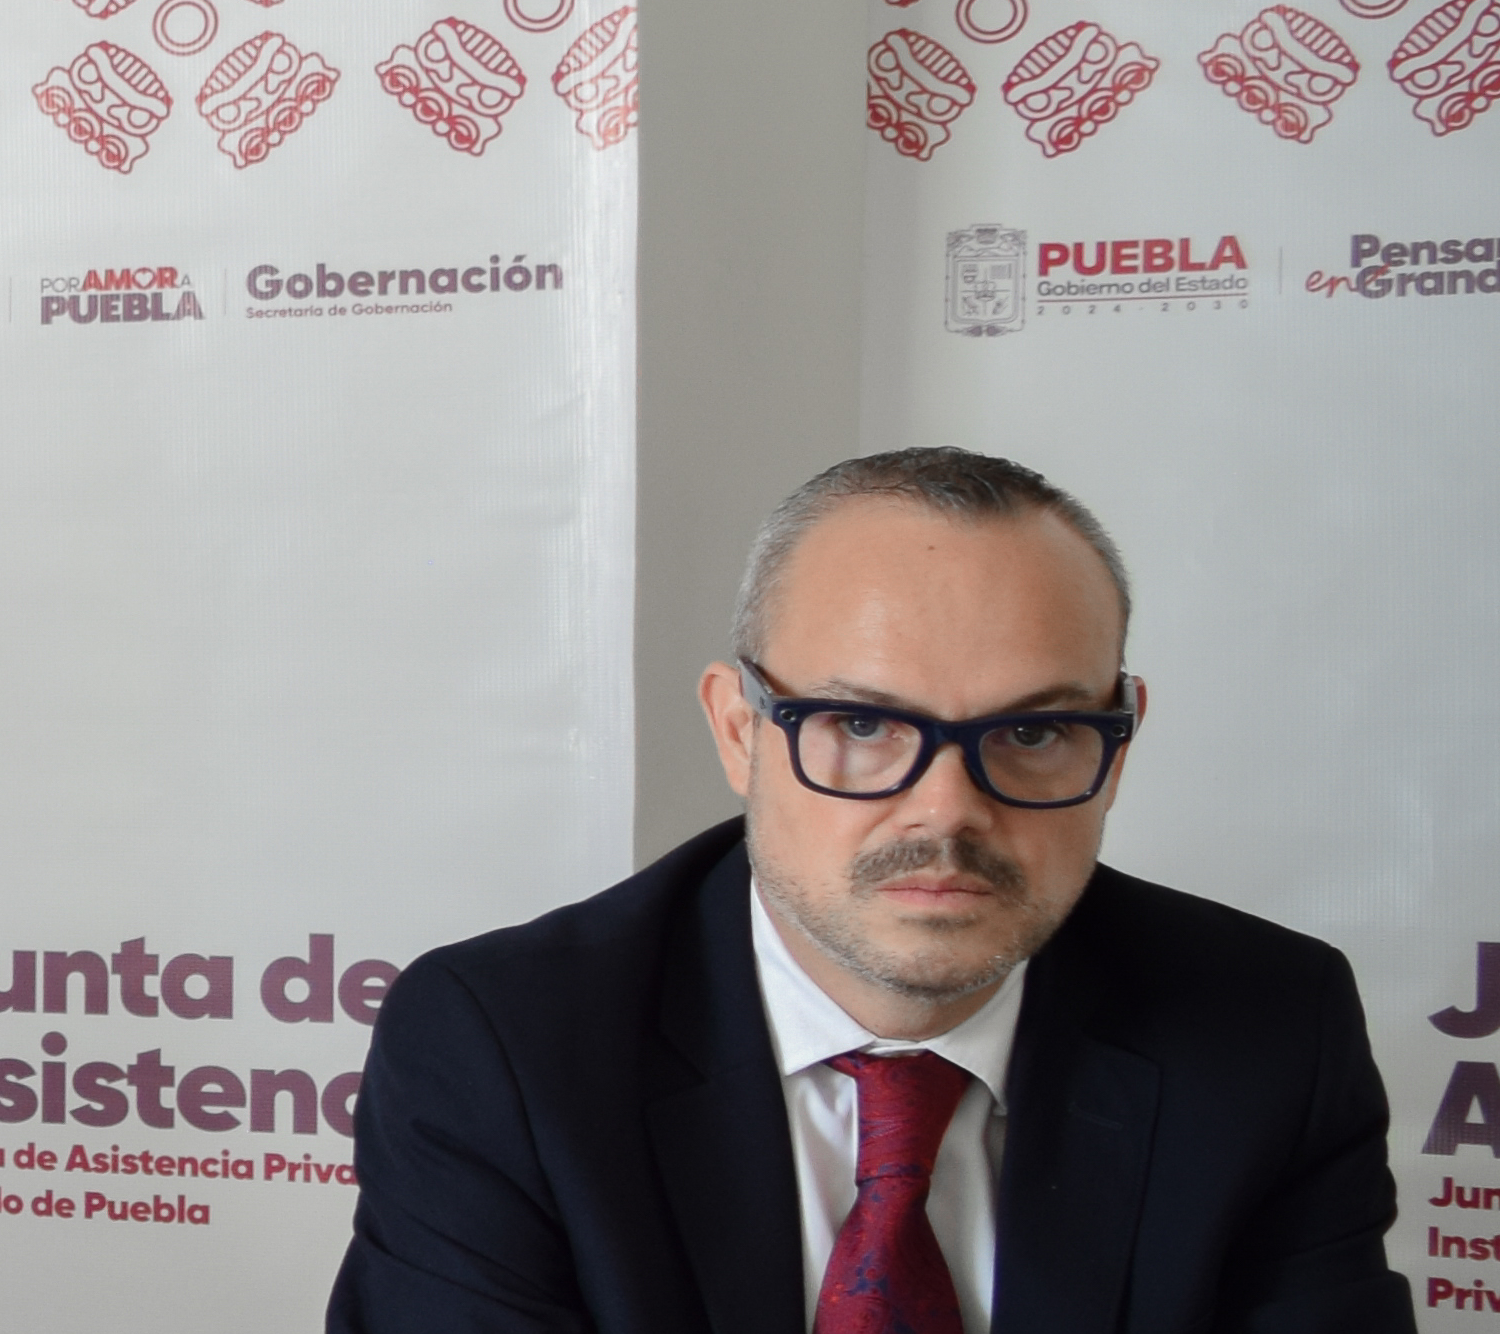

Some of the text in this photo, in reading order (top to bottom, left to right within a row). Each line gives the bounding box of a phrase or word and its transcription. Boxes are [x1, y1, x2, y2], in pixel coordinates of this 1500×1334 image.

[1036, 234, 1249, 278] PUEBLA
[244, 253, 565, 302] Gobernación
[1036, 275, 1249, 298] Gobierno del Estado
[40, 289, 207, 326] PUEBLA
[244, 300, 453, 321] Secretaría de Gobernación
[259, 932, 402, 1027] de
[12, 1141, 58, 1173] de
[64, 1144, 255, 1181] Asistencia
[263, 1152, 361, 1188] Priva
[30, 1189, 76, 1220] de
[83, 1190, 211, 1226] Puebla
